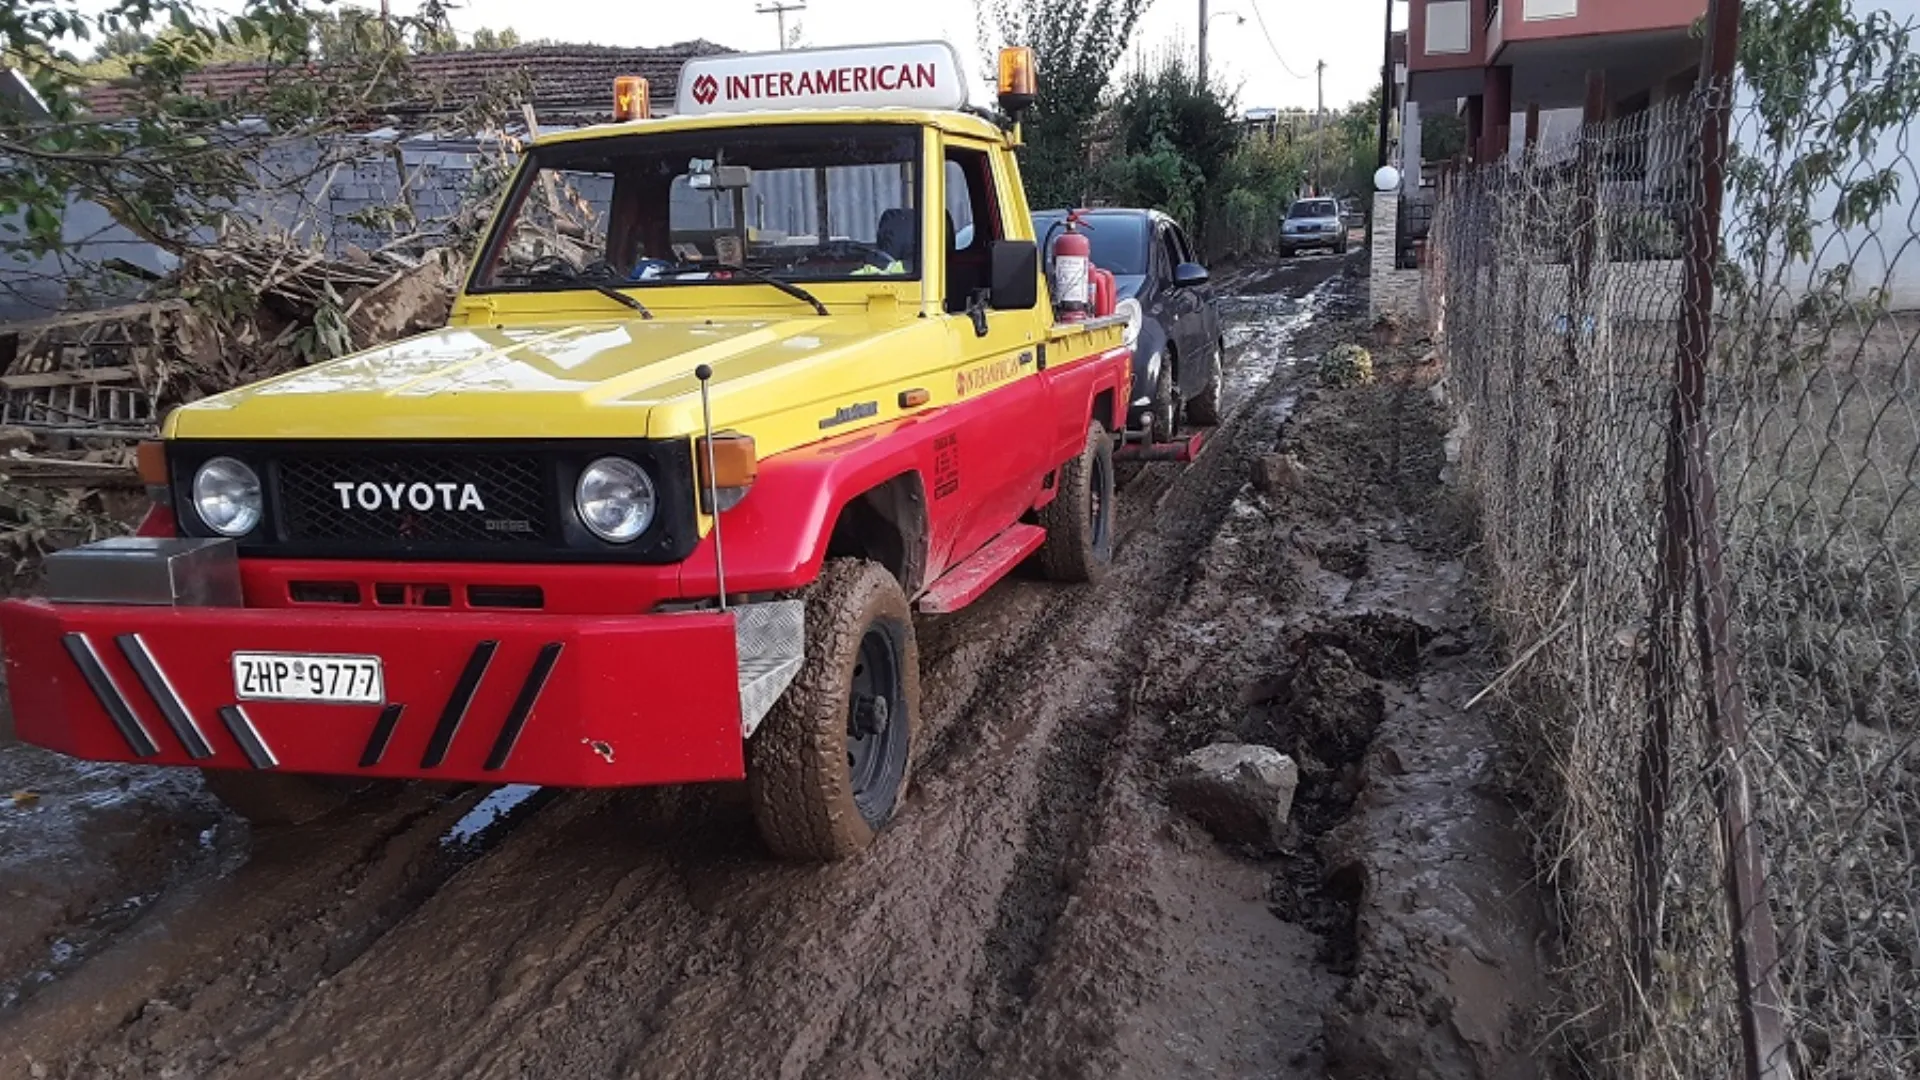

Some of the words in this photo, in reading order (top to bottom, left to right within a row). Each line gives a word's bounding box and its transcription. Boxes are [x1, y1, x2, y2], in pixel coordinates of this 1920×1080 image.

[726, 62, 935, 100] INTERAMERICAN
[333, 481, 485, 511] TOYOTA
[485, 519, 533, 532] DIESEL
